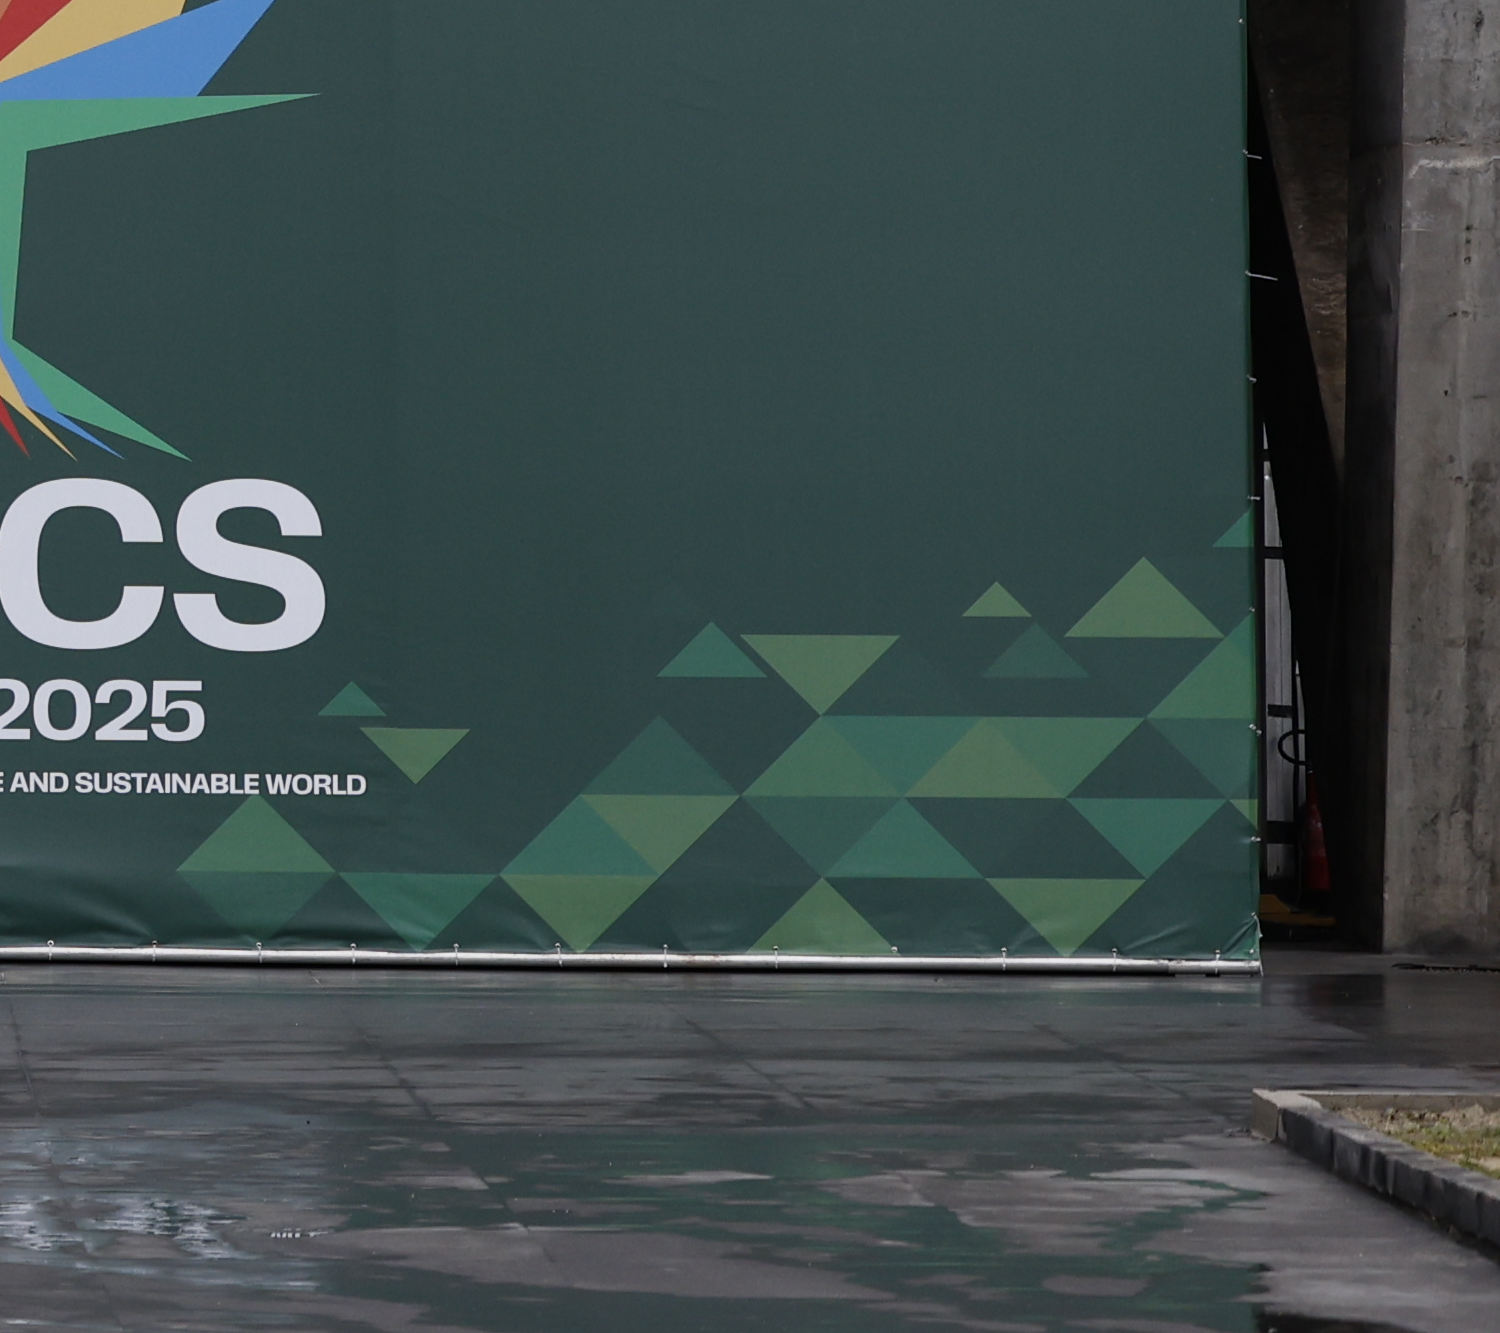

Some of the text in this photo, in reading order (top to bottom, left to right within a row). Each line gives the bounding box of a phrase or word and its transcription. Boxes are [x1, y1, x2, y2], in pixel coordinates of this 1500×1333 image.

[9, 771, 70, 794] AND
[74, 771, 260, 796] SUSTAINABLE
[264, 773, 367, 796] WORLD
